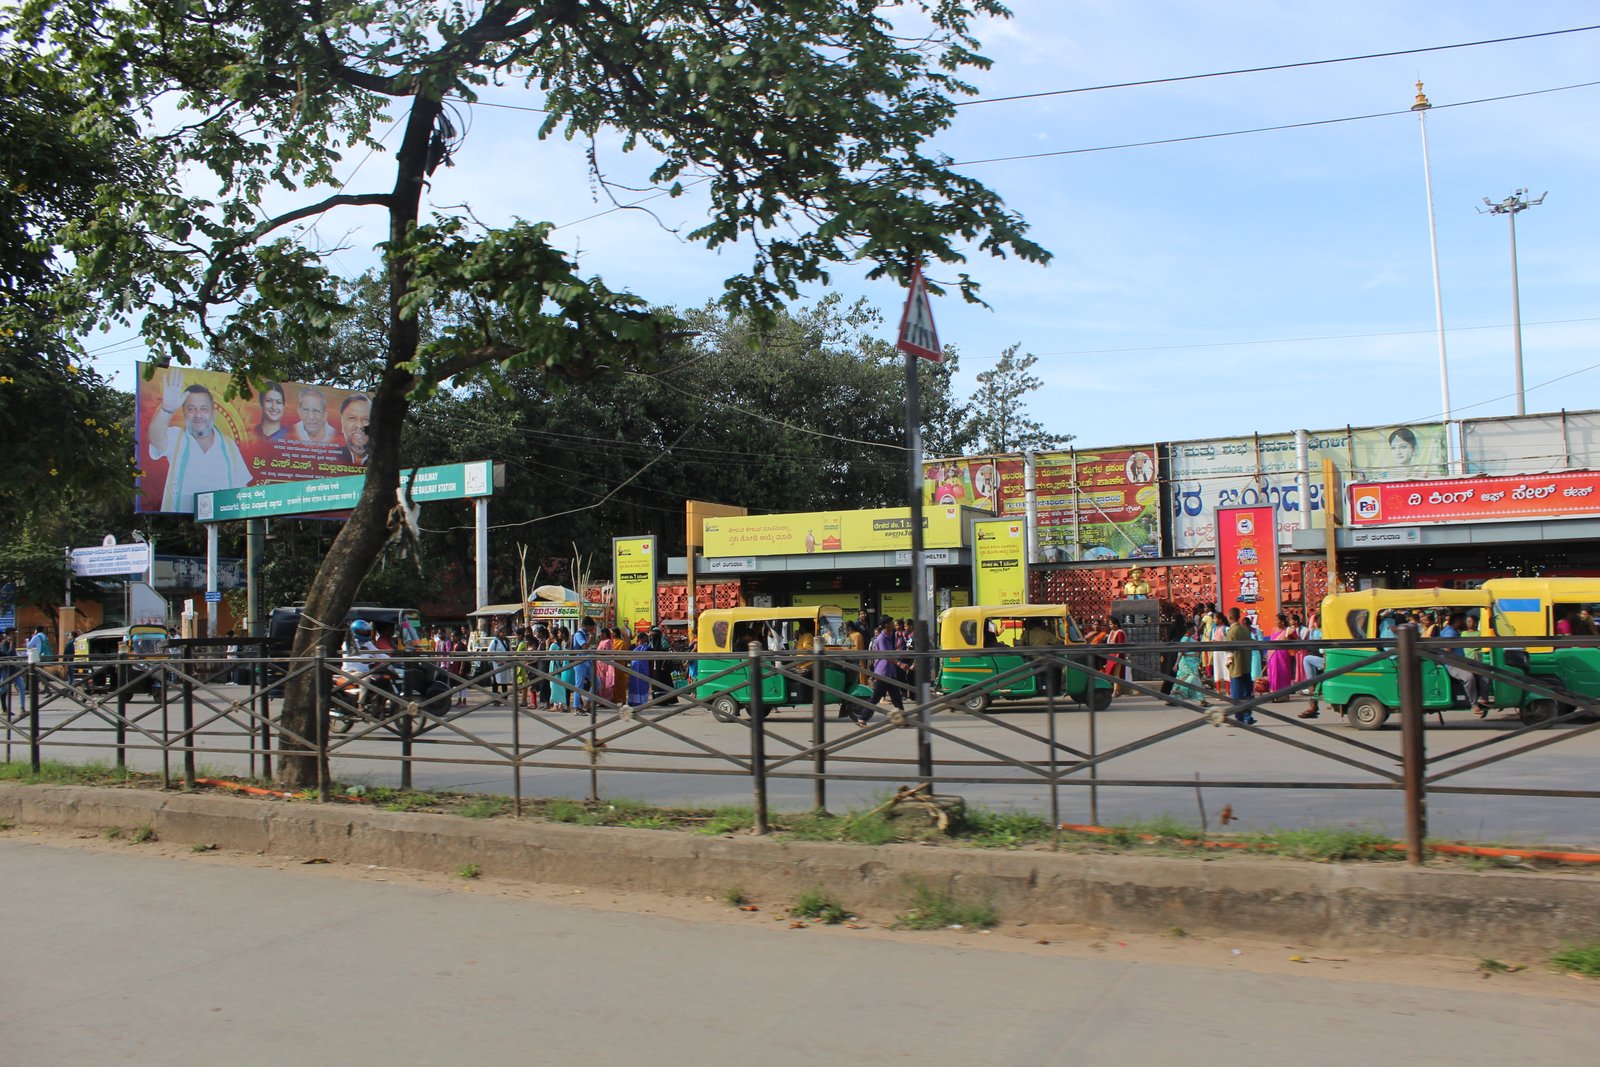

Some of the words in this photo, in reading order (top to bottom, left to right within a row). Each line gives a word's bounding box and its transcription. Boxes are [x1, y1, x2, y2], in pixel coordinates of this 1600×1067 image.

[1184, 446, 1215, 460] ಮತ್ತು
[252, 456, 266, 469] ಶ್ರೀ
[1408, 493, 1422, 505] ದಿ
[1429, 488, 1474, 504] ಕಿಂಗ್
[1481, 491, 1505, 502] ಆಫ್
[1512, 484, 1556, 500] ಸೇಲ್
[1563, 486, 1593, 497] ಈಸ್
[1360, 499, 1376, 511] Pai
[1240, 577, 1259, 590] 25
